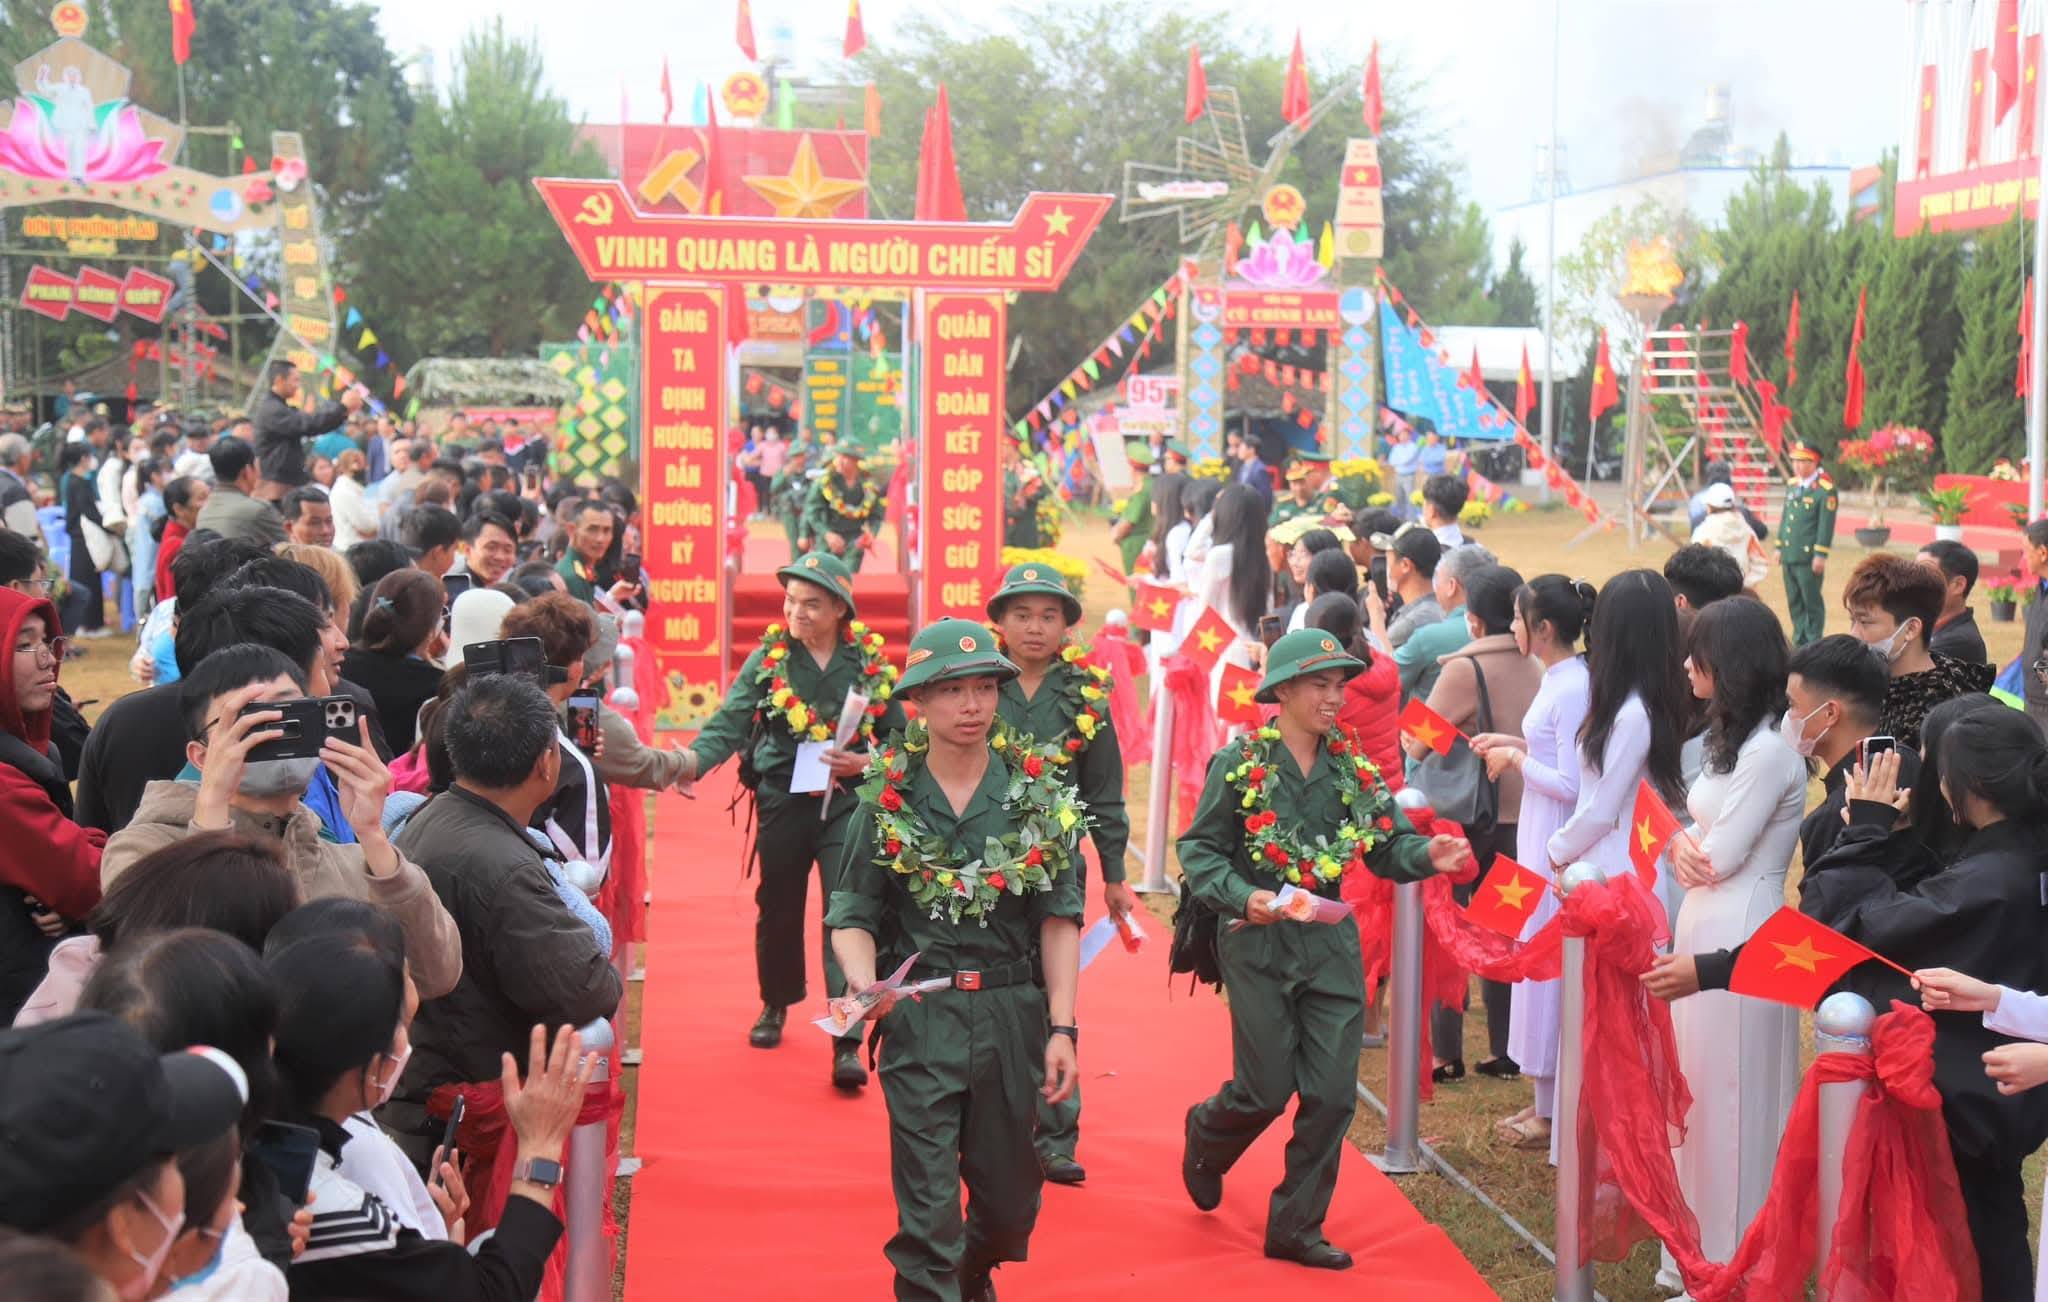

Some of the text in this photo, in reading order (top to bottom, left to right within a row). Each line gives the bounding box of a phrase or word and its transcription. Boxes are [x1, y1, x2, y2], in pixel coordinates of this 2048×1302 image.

[595, 233, 1056, 279] VINH QUANG LÀ NGƯỜI CHIẾN SĨ
[659, 303, 708, 333] ĐẢNG
[937, 309, 991, 340] QUÂN
[672, 347, 696, 372] TA
[944, 348, 984, 377] DÂN
[661, 387, 706, 416] ĐỊNH
[936, 387, 990, 416] ĐOÀN
[1130, 378, 1165, 403] 95
[653, 420, 714, 450] HƯỚNG
[945, 423, 982, 455] KẾT
[943, 464, 983, 492] GÓP
[653, 498, 713, 527] ĐƯỜNG
[942, 502, 982, 531] SỨC
[945, 540, 981, 569] GIỮ
[650, 574, 716, 604] NGUYÊN
[942, 578, 981, 608] QUÊ
[665, 612, 700, 641] MỚI
